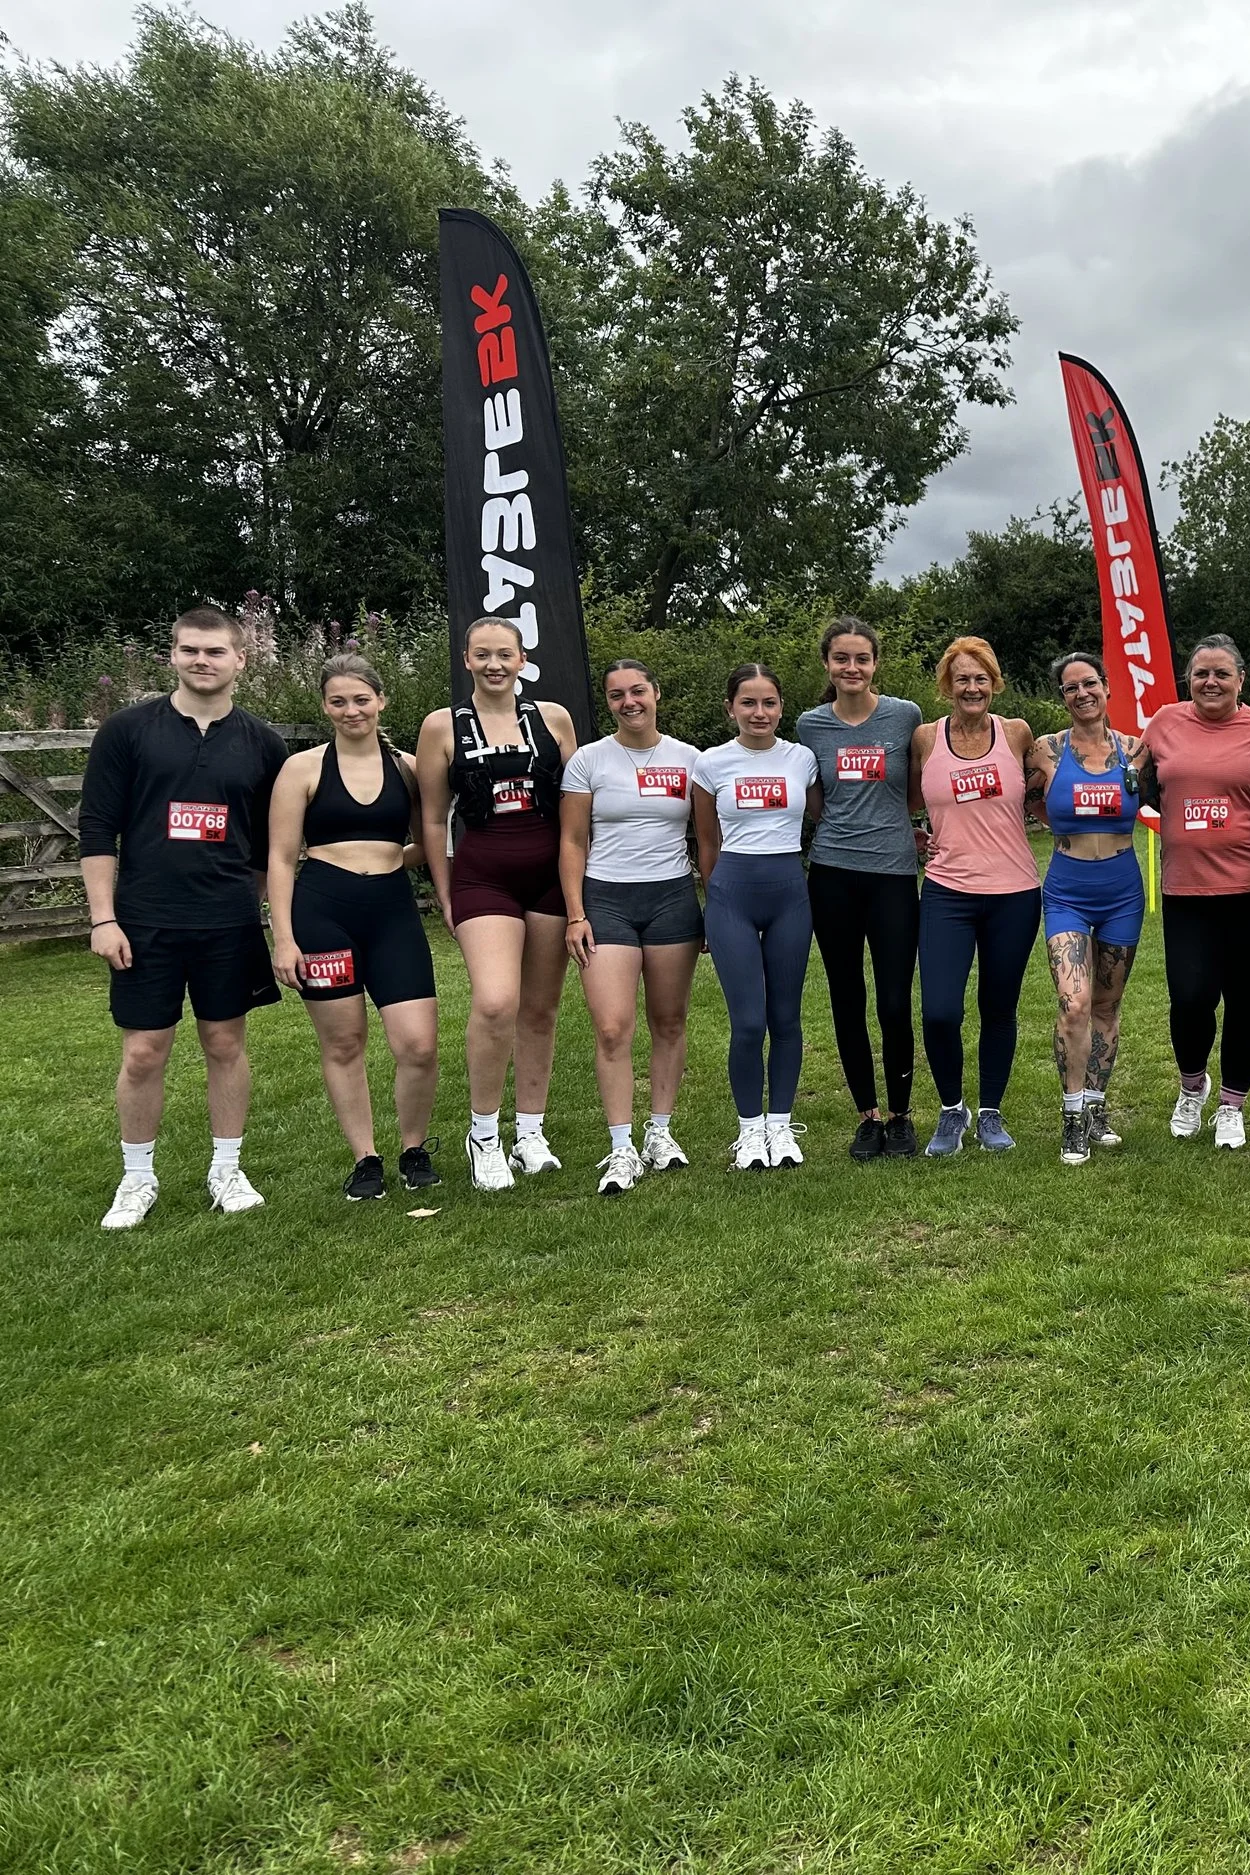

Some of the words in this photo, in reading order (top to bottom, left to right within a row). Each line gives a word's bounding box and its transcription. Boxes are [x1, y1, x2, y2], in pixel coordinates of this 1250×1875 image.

[841, 756, 880, 770] 01177
[867, 770, 880, 779] 5K
[645, 775, 681, 787] 01118
[956, 772, 996, 792] 01178
[741, 785, 782, 798] 01176
[985, 788, 998, 797] 5K
[769, 798, 783, 808] 5K
[1080, 792, 1114, 805] 01117
[1104, 806, 1117, 814] 5K
[1185, 806, 1228, 820] 00769
[170, 812, 226, 829] 00768
[1212, 820, 1224, 828] 5K
[206, 829, 220, 840] 5K
[310, 962, 346, 977] 01111
[336, 976, 350, 985] 5K
